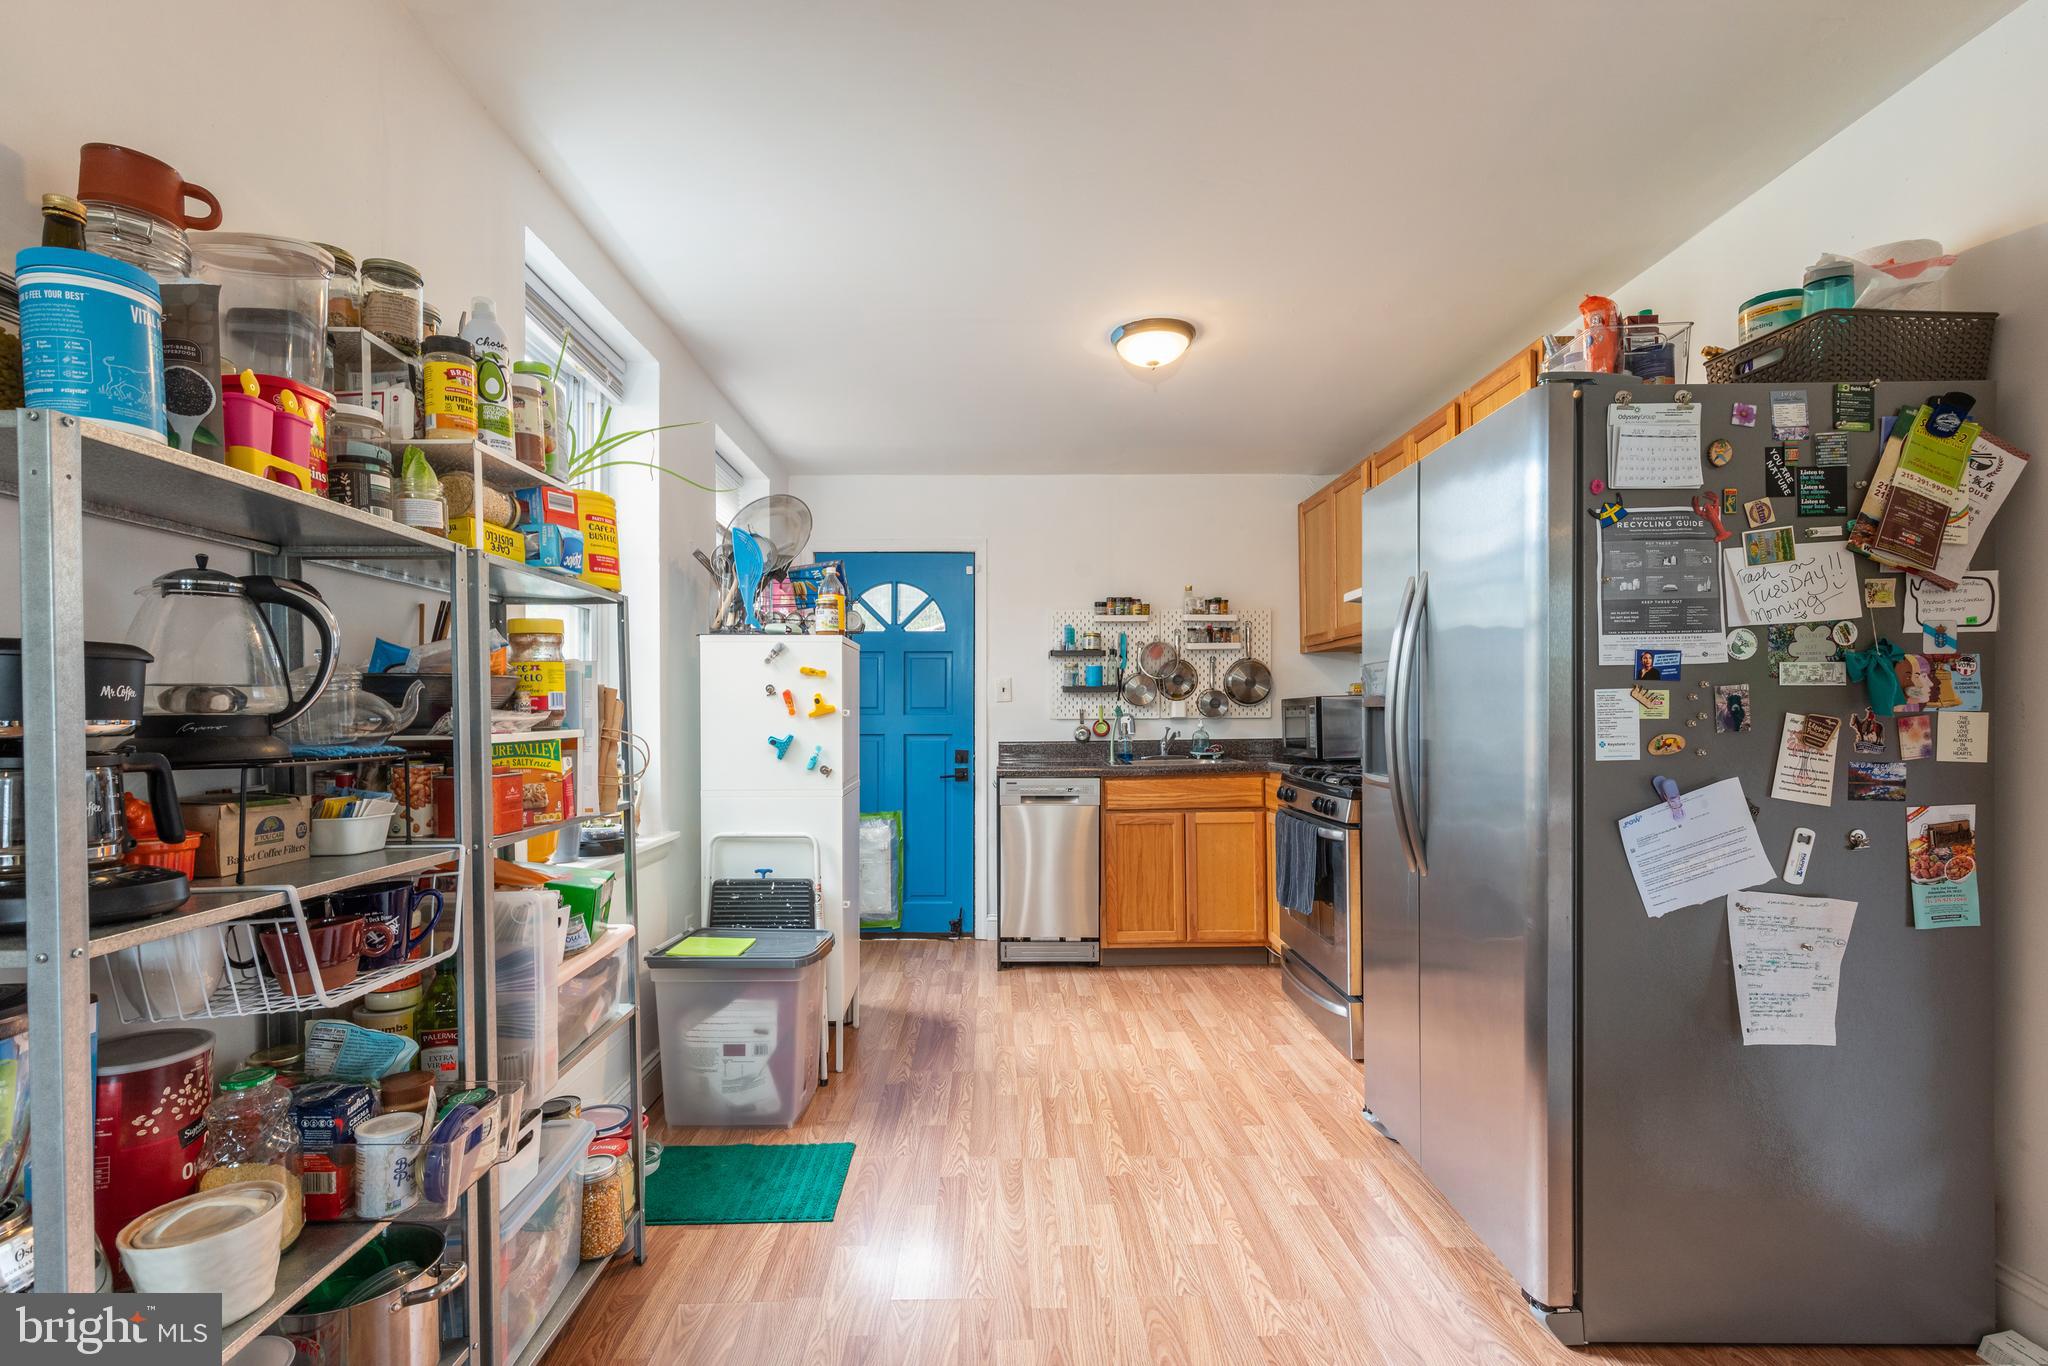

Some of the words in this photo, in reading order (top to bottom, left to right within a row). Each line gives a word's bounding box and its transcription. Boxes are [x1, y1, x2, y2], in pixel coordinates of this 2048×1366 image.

[29, 290, 41, 300] FEEL
[44, 290, 62, 300] YOUR
[65, 291, 84, 301] BEST
[130, 305, 156, 328] VITAL
[1770, 448, 1783, 465] YOU
[1780, 467, 1794, 484] ARE
[1766, 460, 1792, 496] NATURE
[589, 522, 609, 533] CAFE
[485, 530, 514, 547] BUSTELO
[491, 542, 511, 555] CAFE
[563, 552, 583, 569] Ziploc
[1737, 567, 1780, 586] Trash
[1789, 557, 1816, 574] on
[1751, 592, 1843, 622] Morning
[100, 685, 115, 698] Mr.
[117, 685, 137, 701] Coffee
[492, 744, 514, 758] URE
[515, 740, 556, 759] VALLEY
[512, 758, 533, 767] SALTY
[533, 760, 552, 768] nut
[88, 802, 103, 816] ffee
[226, 852, 255, 866] Baket
[257, 848, 282, 860] Coffee
[284, 844, 306, 856] Filters
[377, 1023, 408, 1033] umbs
[349, 1108, 369, 1126] CREMA
[353, 1114, 370, 1130] USTO
